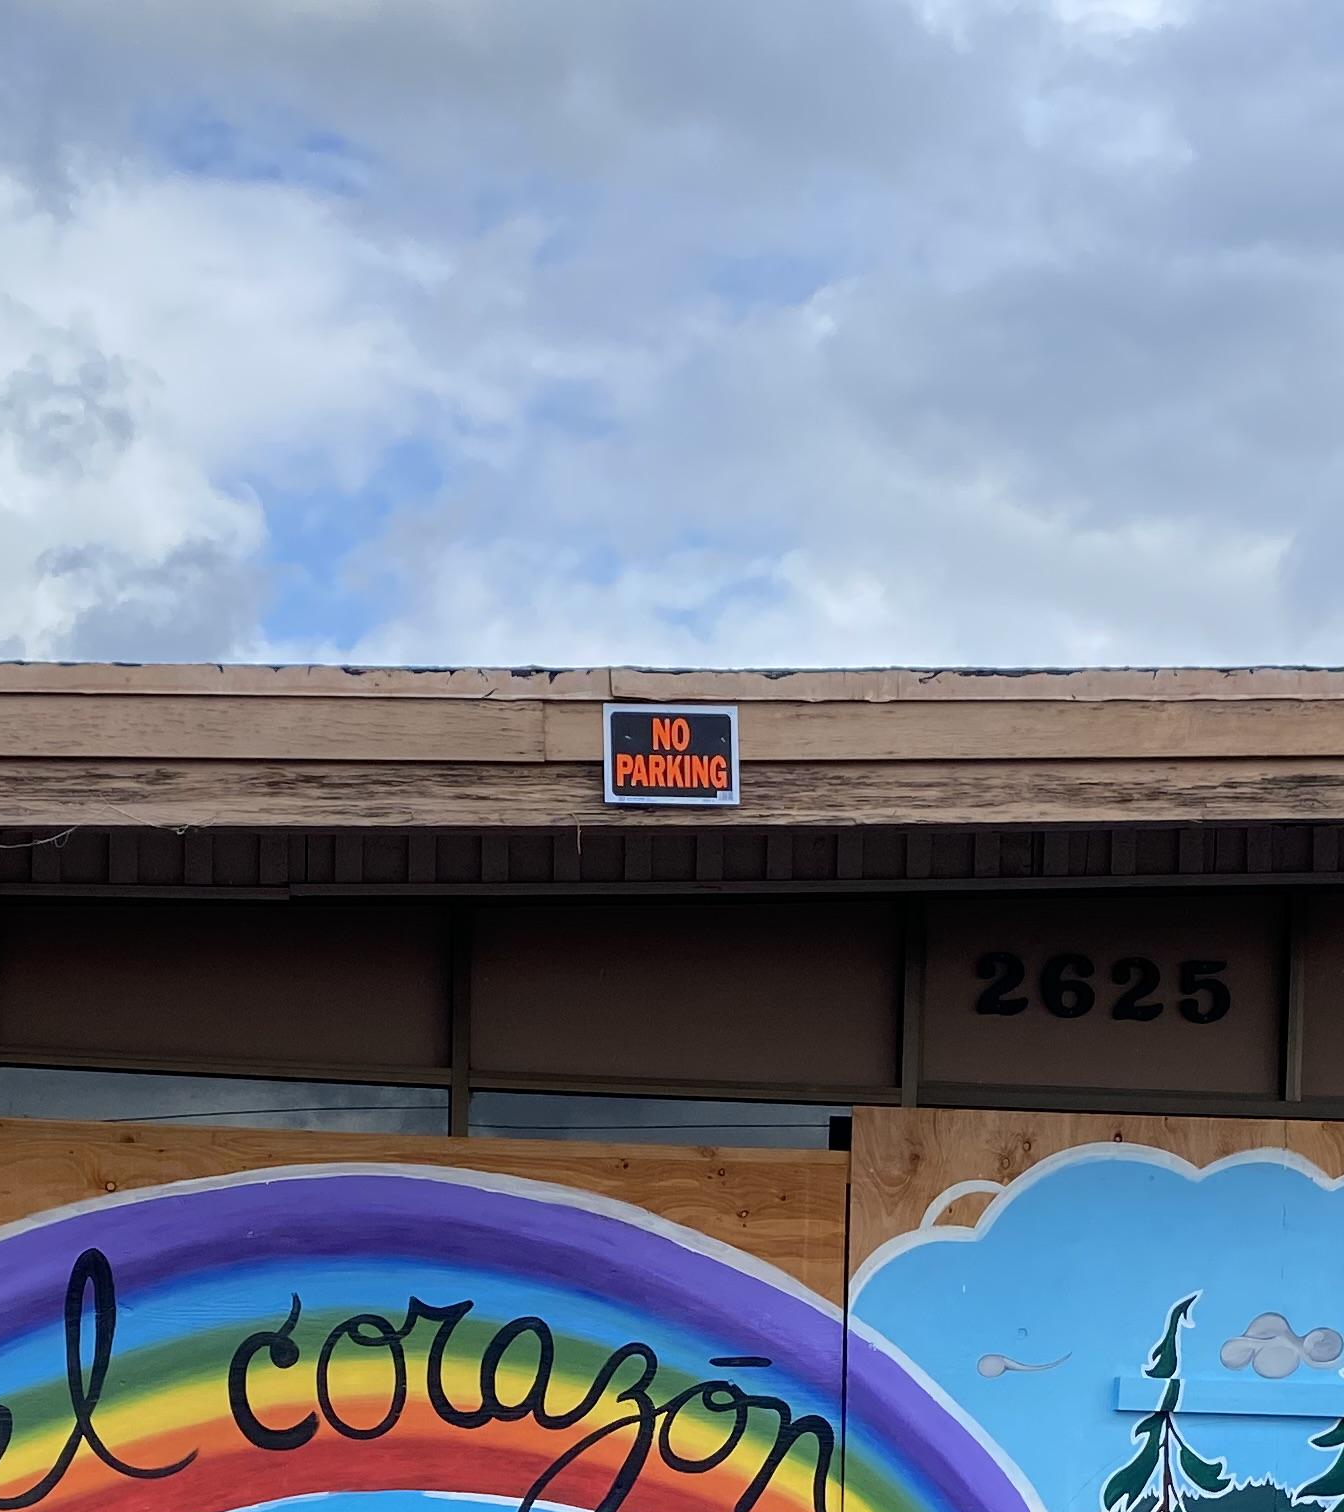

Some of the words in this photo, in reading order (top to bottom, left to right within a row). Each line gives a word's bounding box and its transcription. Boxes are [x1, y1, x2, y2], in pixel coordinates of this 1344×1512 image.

[652, 717, 691, 752] NO
[616, 753, 729, 789] PARKING
[975, 951, 1232, 1025] 2625
